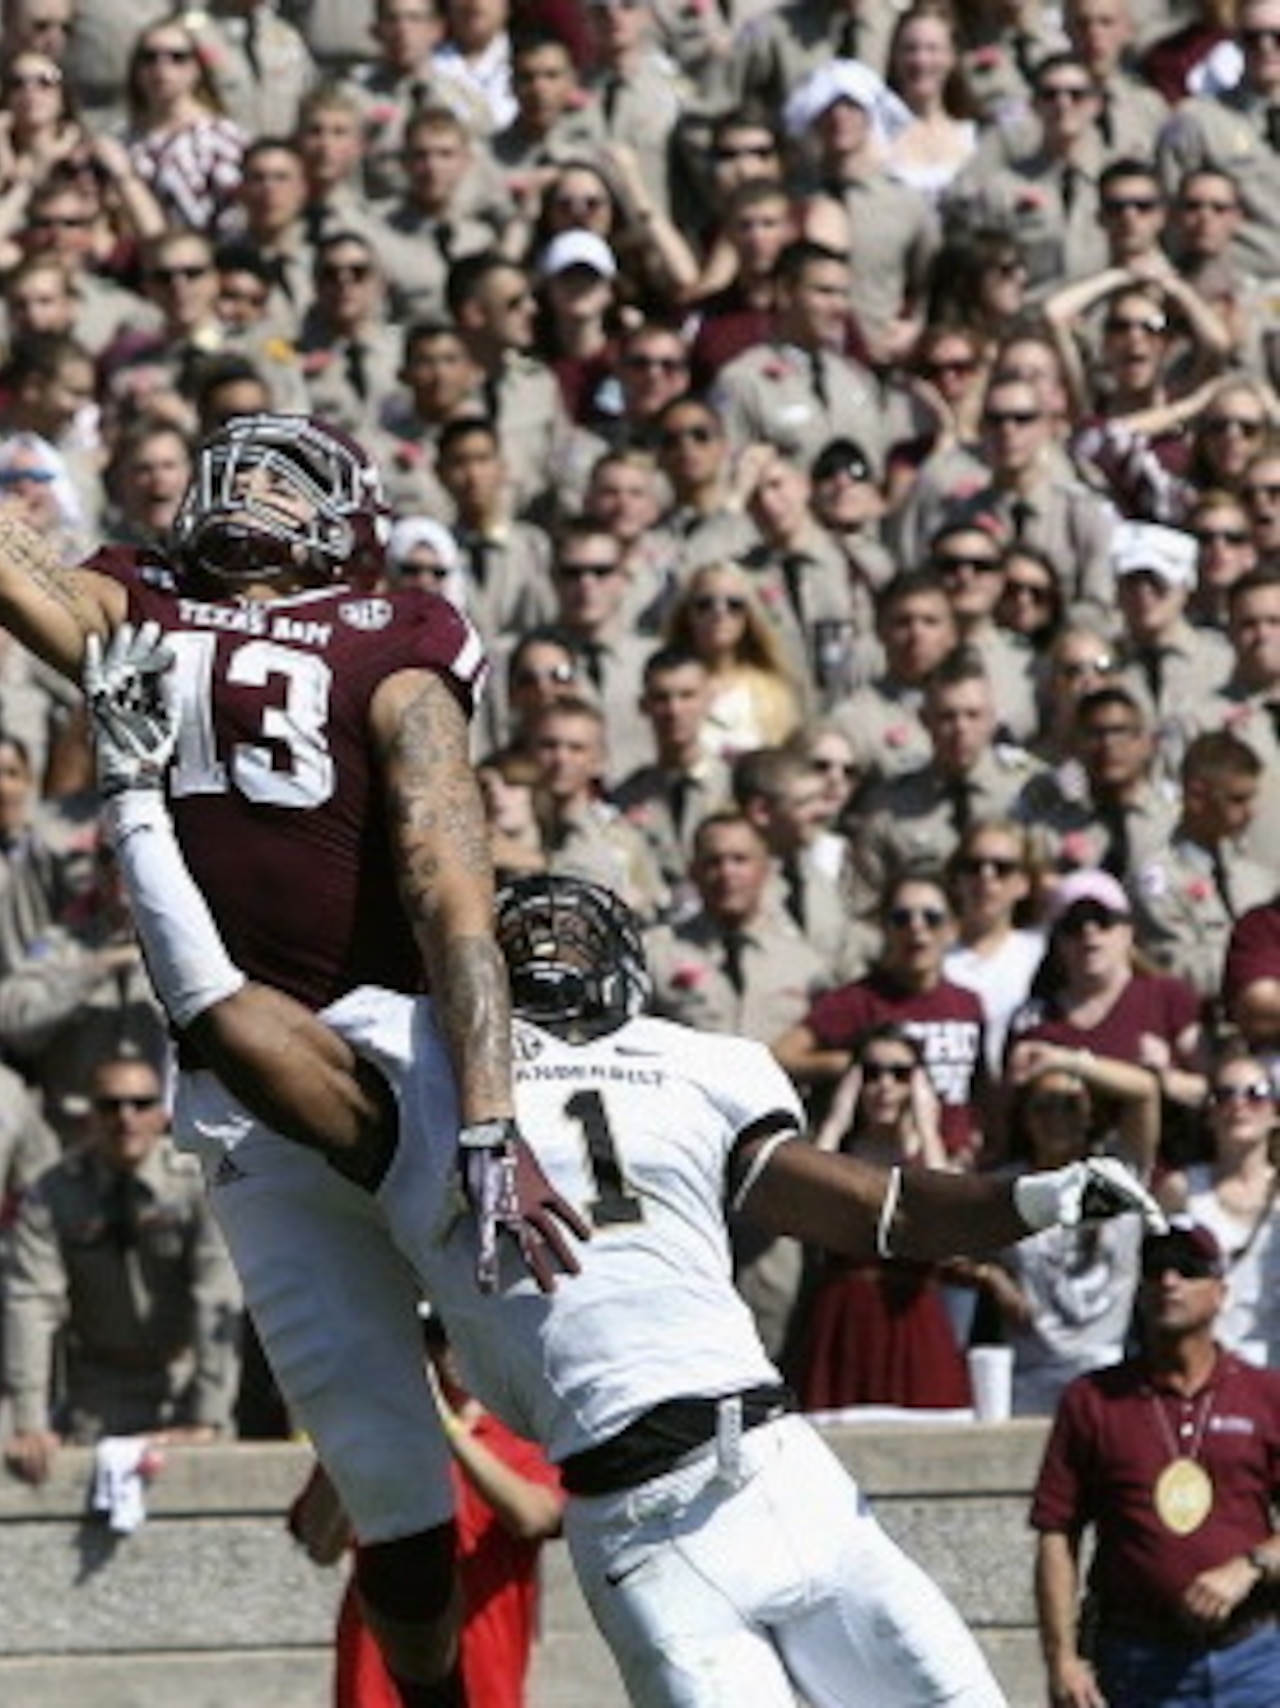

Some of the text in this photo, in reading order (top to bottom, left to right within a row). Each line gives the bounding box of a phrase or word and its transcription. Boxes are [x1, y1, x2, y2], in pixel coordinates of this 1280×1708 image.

[177, 599, 333, 646] TEXAS A&M
[158, 631, 334, 809] 13
[516, 1064, 663, 1087] ANDERBILT
[563, 1087, 643, 1224] 1
